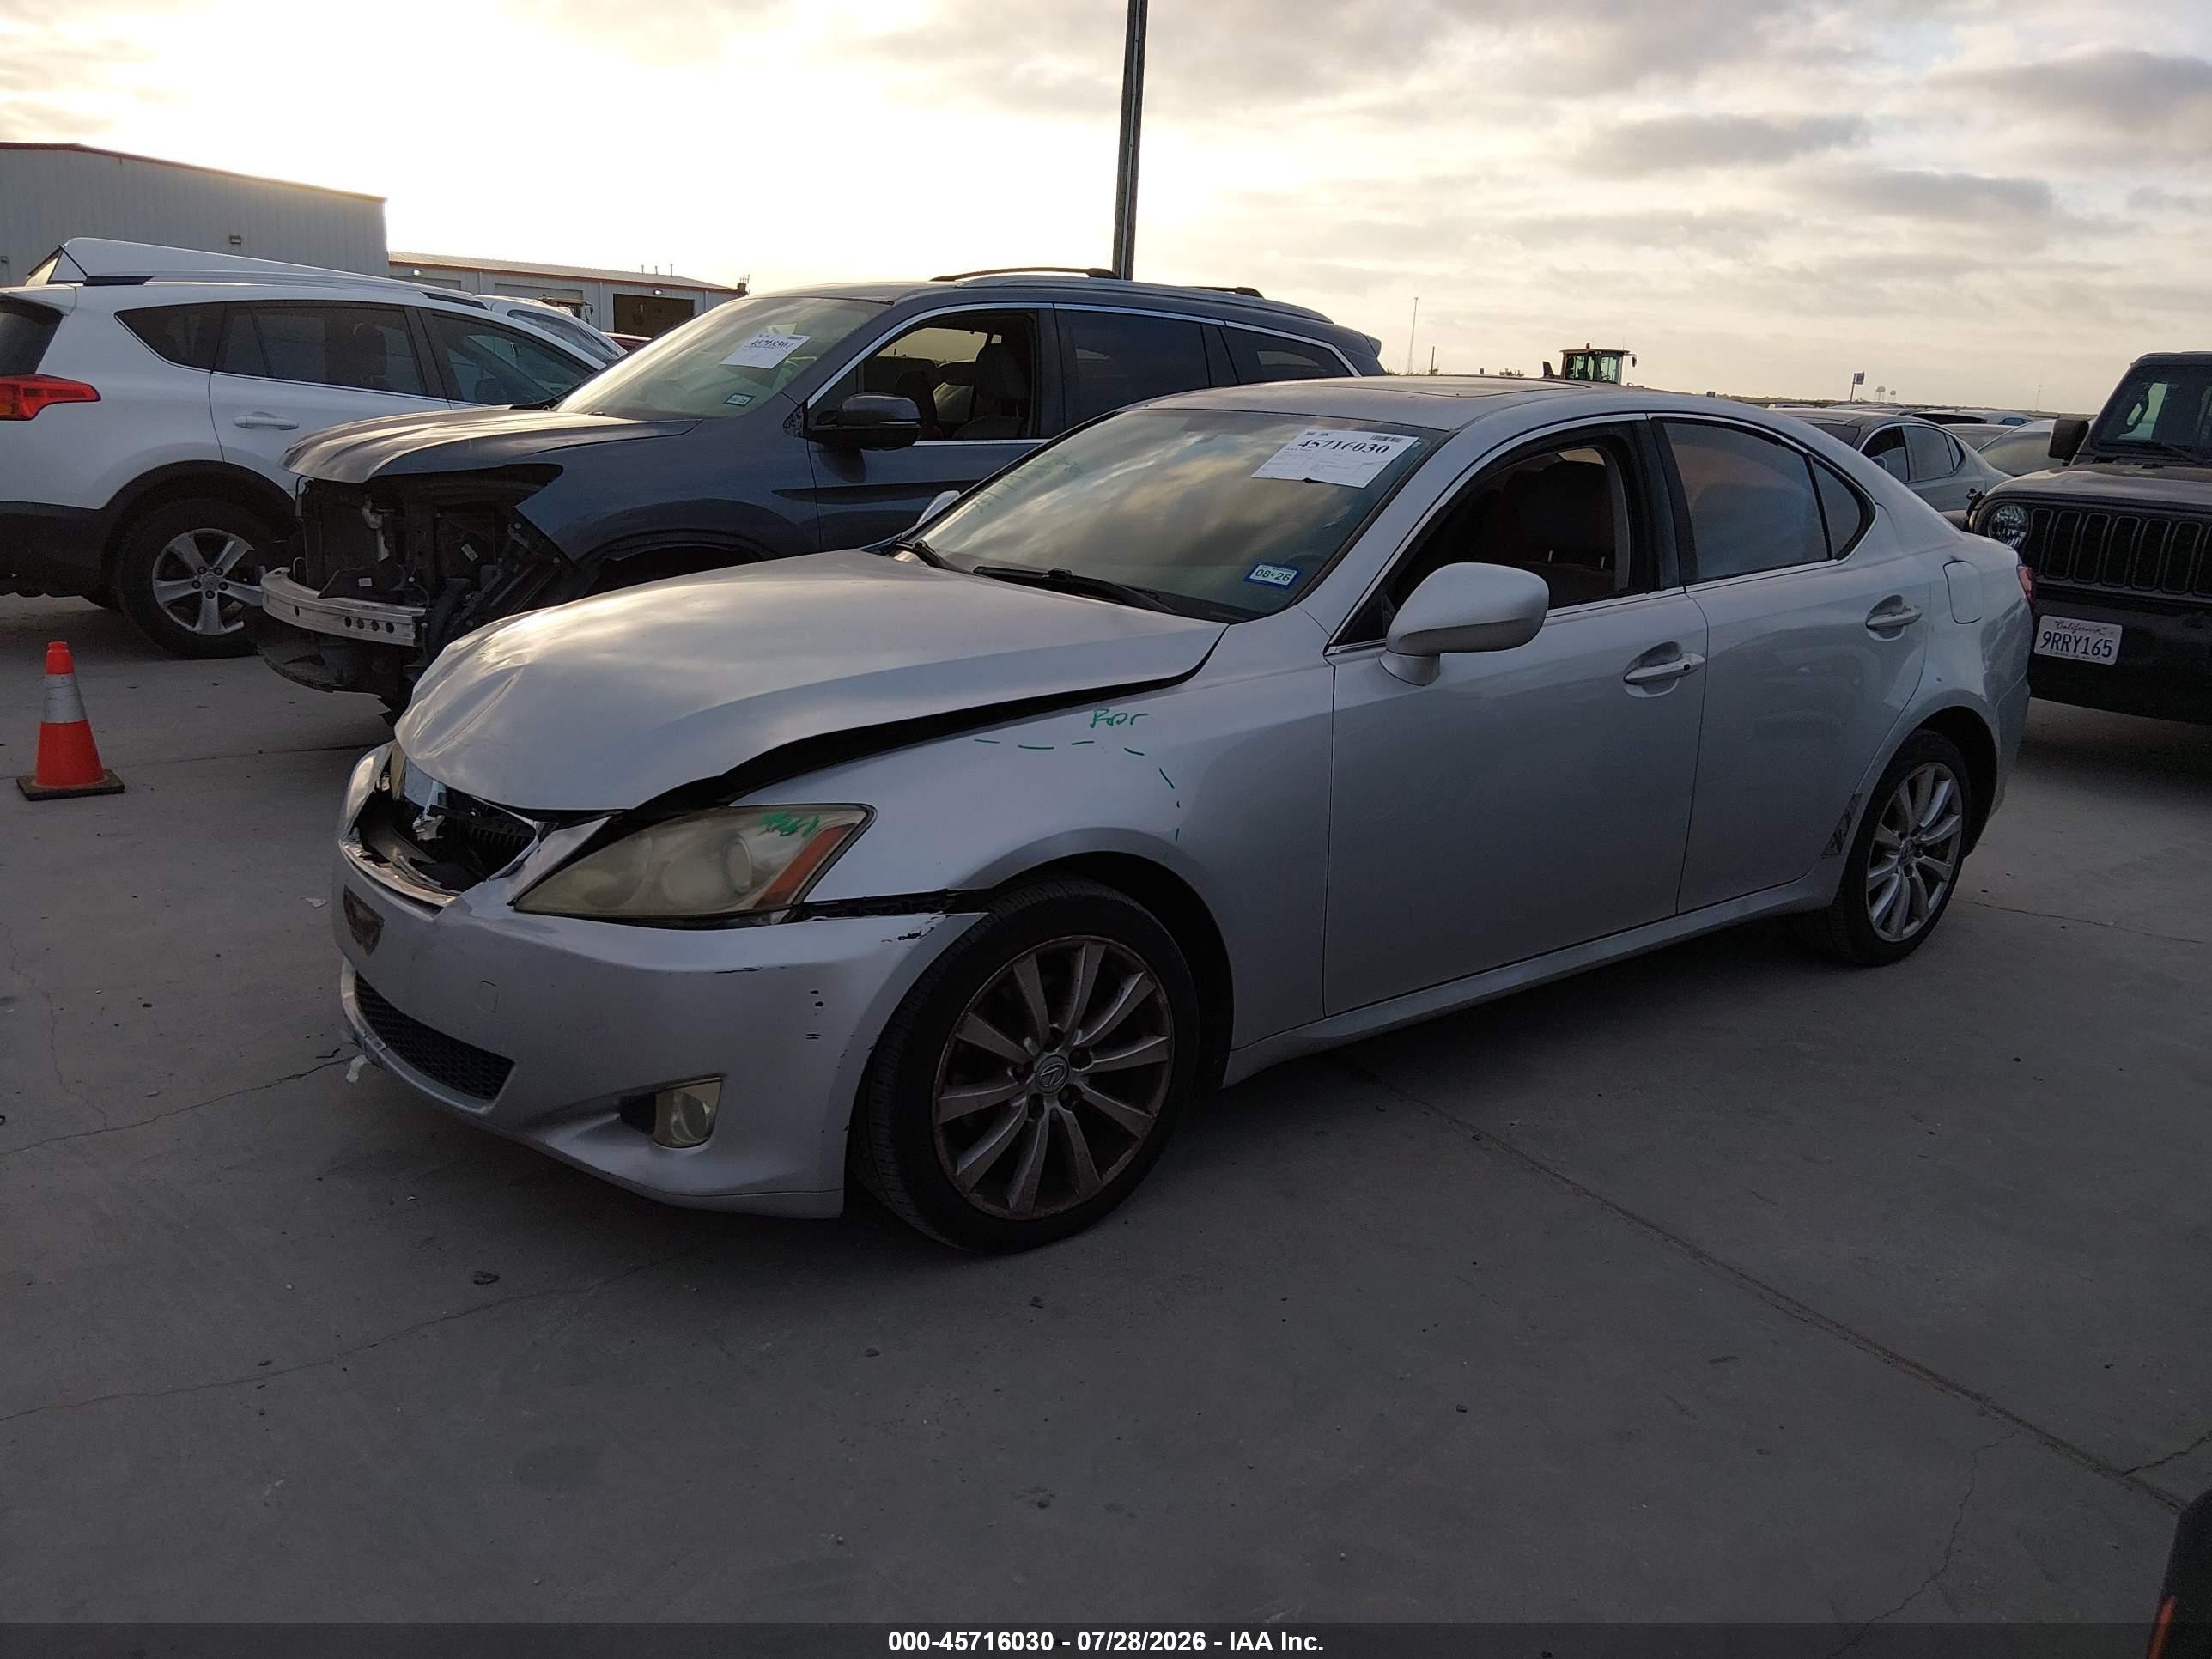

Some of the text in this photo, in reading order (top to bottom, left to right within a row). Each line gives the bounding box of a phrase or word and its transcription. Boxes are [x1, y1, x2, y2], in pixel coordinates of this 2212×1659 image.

[1298, 439, 1390, 454] 45716030
[2055, 620, 2105, 635] California
[2040, 630, 2113, 658] 9RRY165
